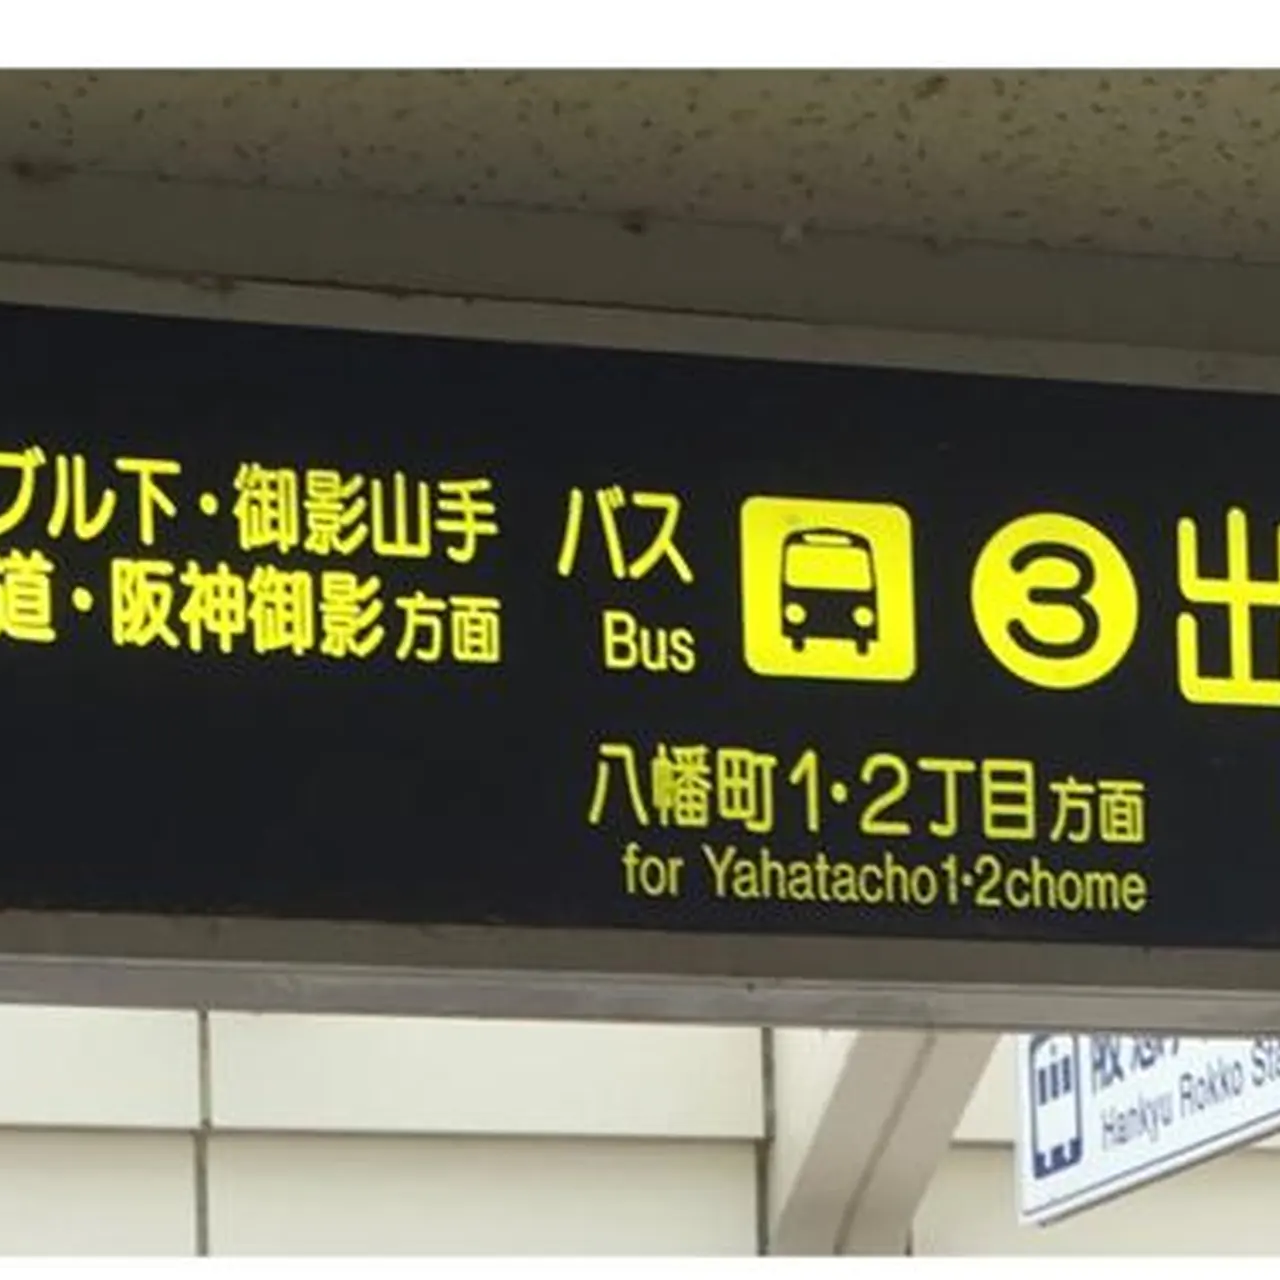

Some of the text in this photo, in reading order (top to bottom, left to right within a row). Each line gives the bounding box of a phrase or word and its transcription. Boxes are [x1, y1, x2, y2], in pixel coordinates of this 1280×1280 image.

[557, 484, 694, 584] バス
[602, 610, 696, 674] Bus
[1003, 541, 1102, 660] 3
[622, 843, 684, 897] for
[1099, 1093, 1175, 1151] Hankyu
[1177, 1056, 1246, 1118] Rokko
